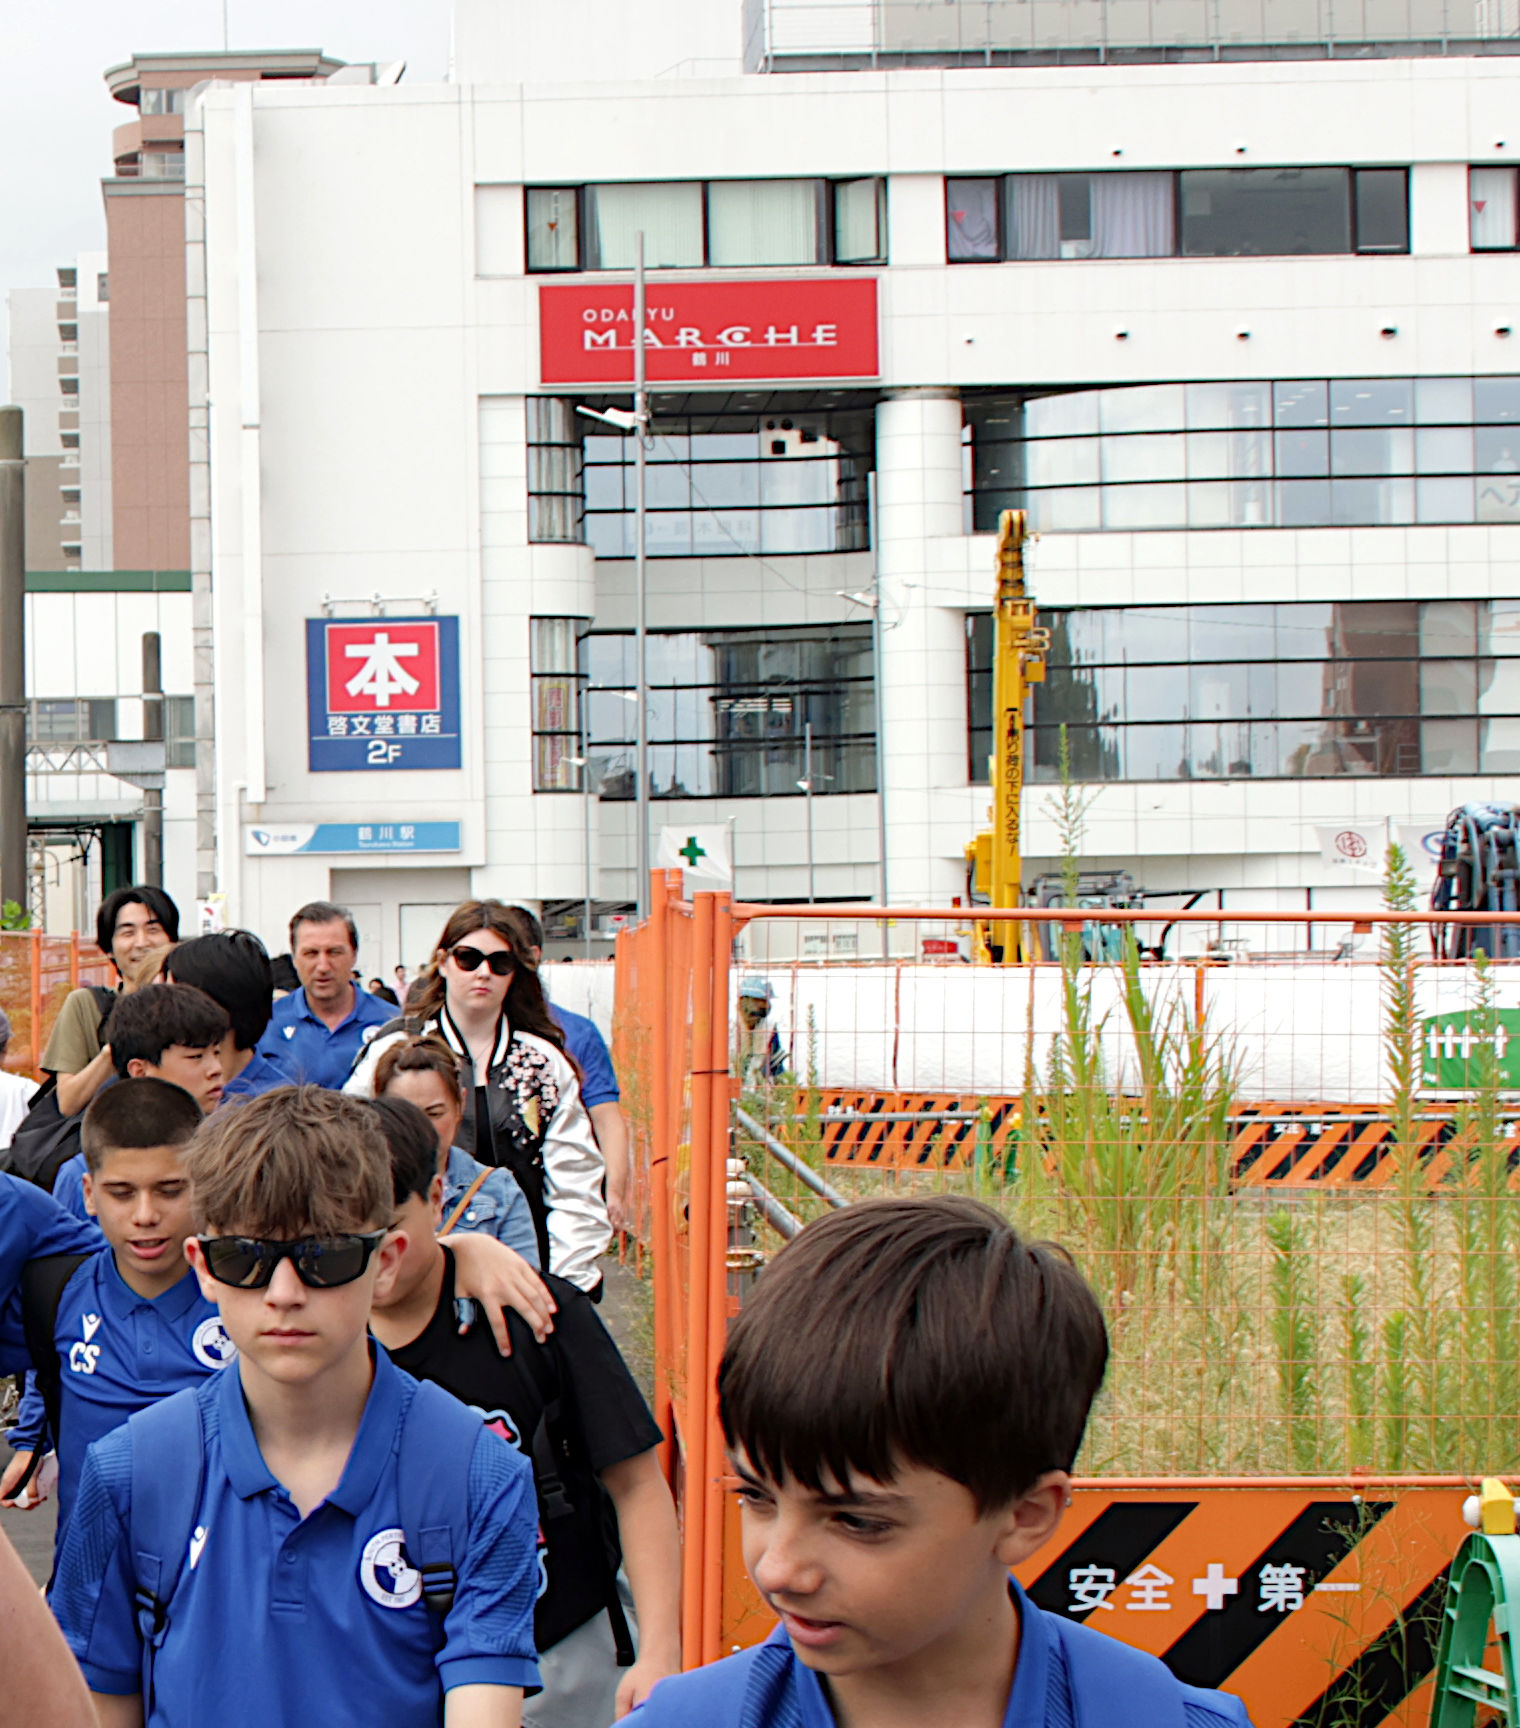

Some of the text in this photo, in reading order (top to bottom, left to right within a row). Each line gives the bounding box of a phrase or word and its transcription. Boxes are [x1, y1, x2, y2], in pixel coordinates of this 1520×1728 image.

[583, 325, 837, 351] MARCHE
[344, 633, 421, 707] 本
[327, 714, 441, 736] 啓文堂書店
[367, 740, 402, 764] 2F
[70, 1341, 102, 1375] CS
[1068, 1563, 1361, 1612] 安全 第一
